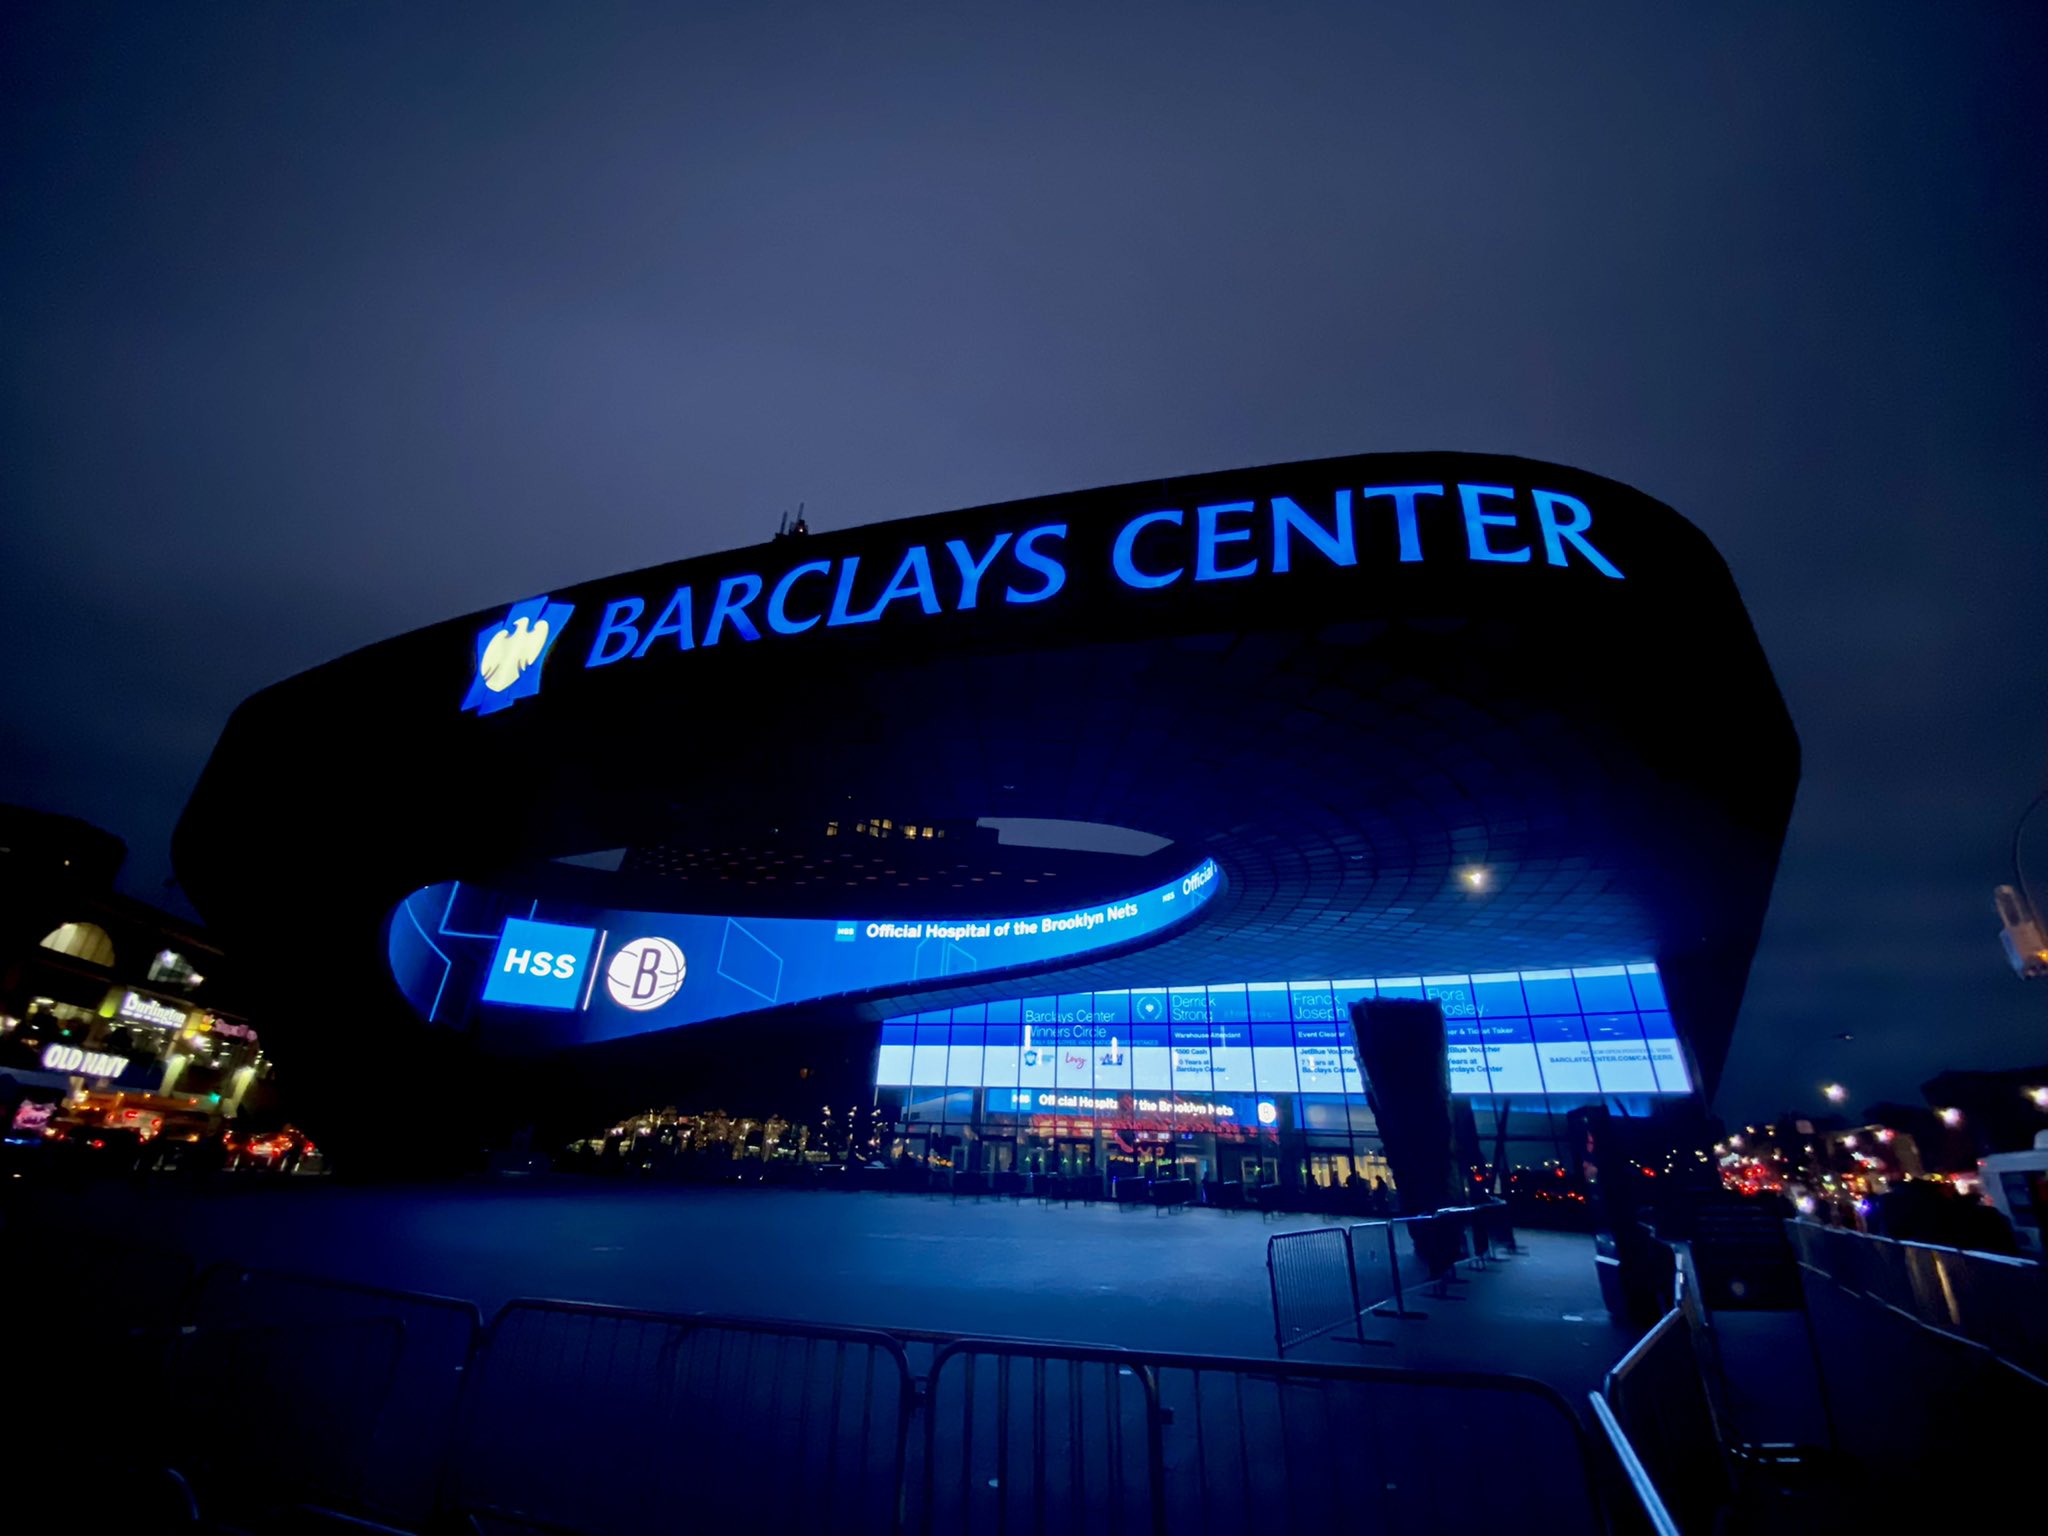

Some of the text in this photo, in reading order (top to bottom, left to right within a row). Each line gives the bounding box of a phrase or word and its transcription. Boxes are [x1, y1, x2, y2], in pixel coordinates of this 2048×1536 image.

[585, 483, 1626, 667] BARCLAYS CENTER
[1182, 860, 1214, 895] Official
[866, 923, 922, 938] Official
[925, 923, 991, 941] Hospital
[993, 921, 1011, 937] of
[1013, 920, 1038, 936] the
[1041, 911, 1105, 933] Brooklyn
[1107, 902, 1139, 923] Nets
[503, 948, 577, 979] HSS
[631, 948, 662, 1000] B
[1293, 992, 1341, 1006] Franck
[1427, 988, 1465, 1001] Flora
[1076, 1009, 1115, 1022] Center
[1172, 1007, 1213, 1023] Strong
[1295, 1006, 1346, 1022] Joseph
[1442, 1001, 1484, 1018] osley
[1073, 1024, 1107, 1038] Circle
[46, 1043, 130, 1078] OLD NAVY
[1302, 1066, 1357, 1075] Baclays Cnter
[1038, 1093, 1077, 1107] Offcial
[1078, 1096, 1119, 1110] Hospita
[1138, 1099, 1157, 1112] the
